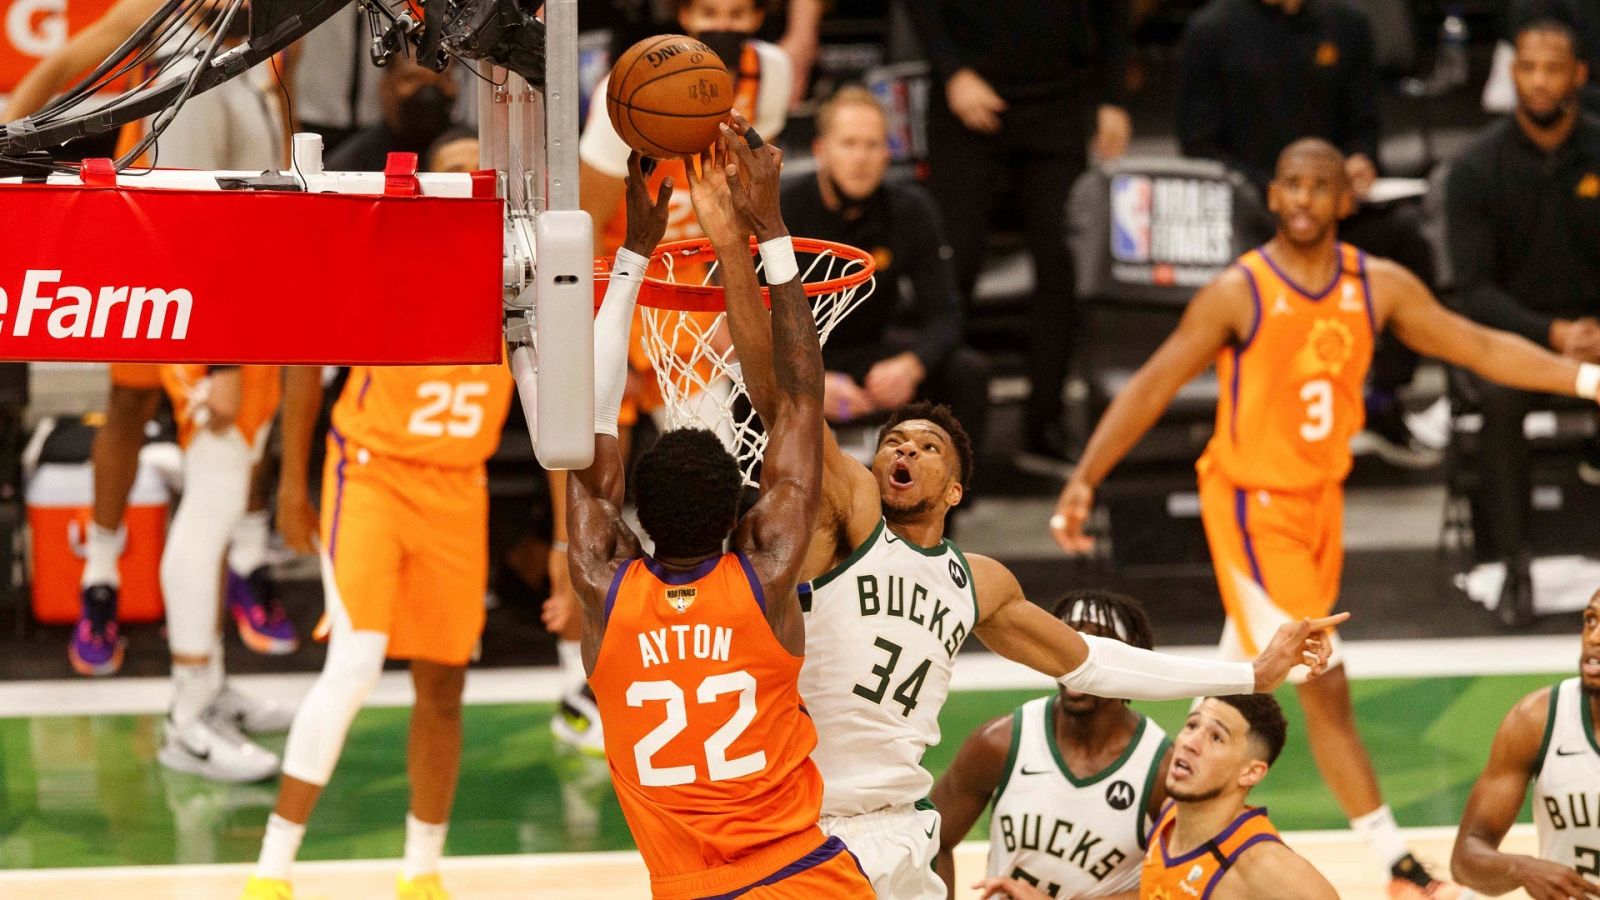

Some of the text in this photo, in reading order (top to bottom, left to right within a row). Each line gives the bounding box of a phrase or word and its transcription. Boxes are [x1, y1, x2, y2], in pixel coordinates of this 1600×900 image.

[6, 0, 67, 57] G
[12, 269, 193, 340] Farm
[408, 381, 489, 437] 25
[1299, 380, 1333, 441] 3
[638, 624, 733, 668] AYTON
[857, 575, 966, 660] BUCKS
[852, 636, 932, 718] 34
[626, 670, 767, 787] 22
[1001, 813, 1126, 882] BUCKS
